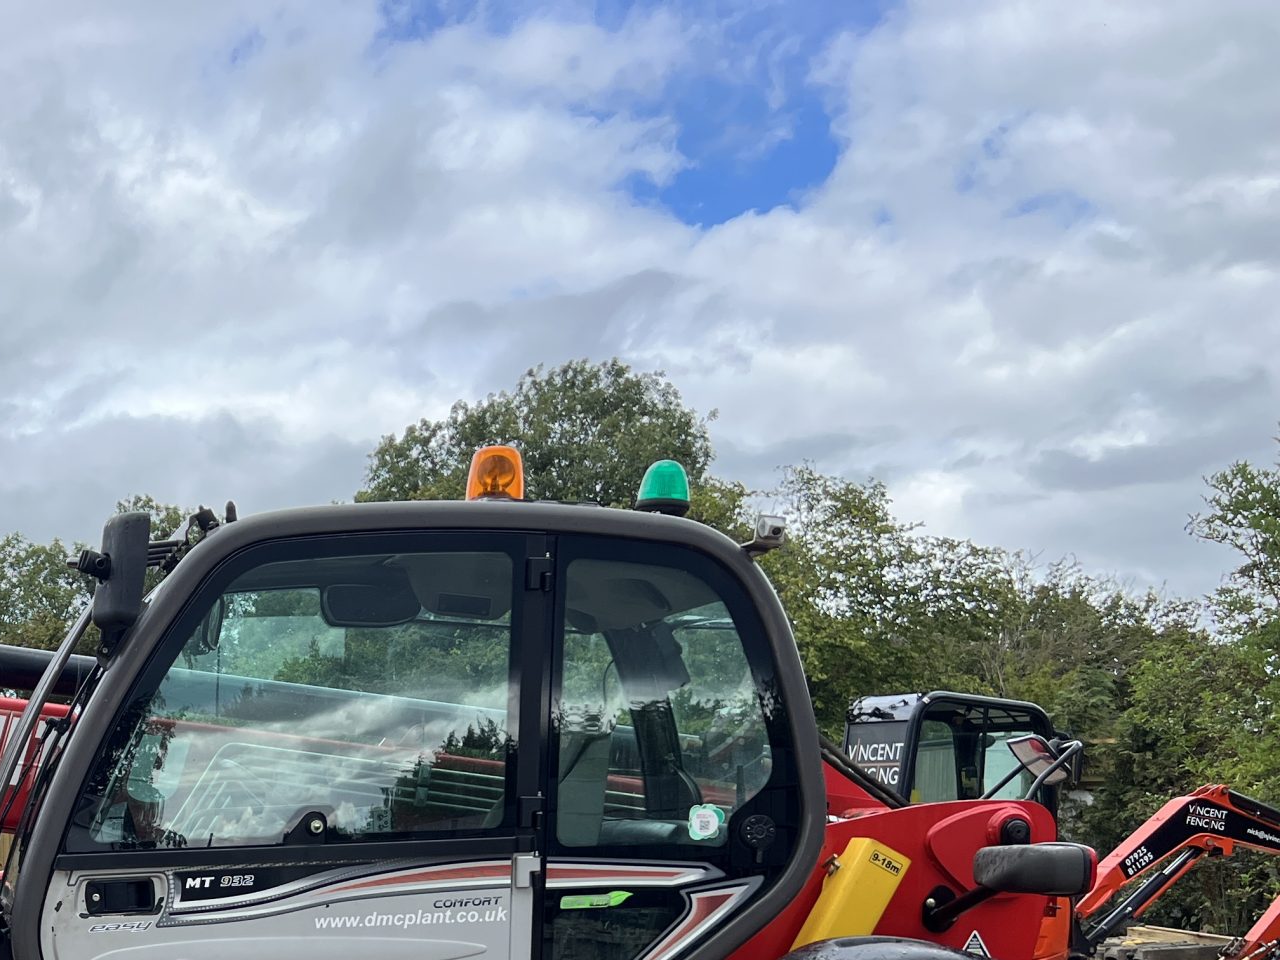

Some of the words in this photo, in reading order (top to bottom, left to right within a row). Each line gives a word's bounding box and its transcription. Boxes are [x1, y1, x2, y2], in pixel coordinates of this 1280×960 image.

[848, 740, 904, 762] VINCENT
[1188, 804, 1228, 819] VINCENT
[1186, 816, 1225, 831] FENCING
[872, 853, 899, 873] 9-18m
[1125, 846, 1147, 866] 07925
[1127, 853, 1154, 876] 811295
[185, 876, 214, 889] MT
[220, 875, 255, 887] 932
[433, 896, 502, 909] COMFORT
[89, 921, 152, 933] easy
[314, 908, 508, 929] www.dmcplant.co.uk
